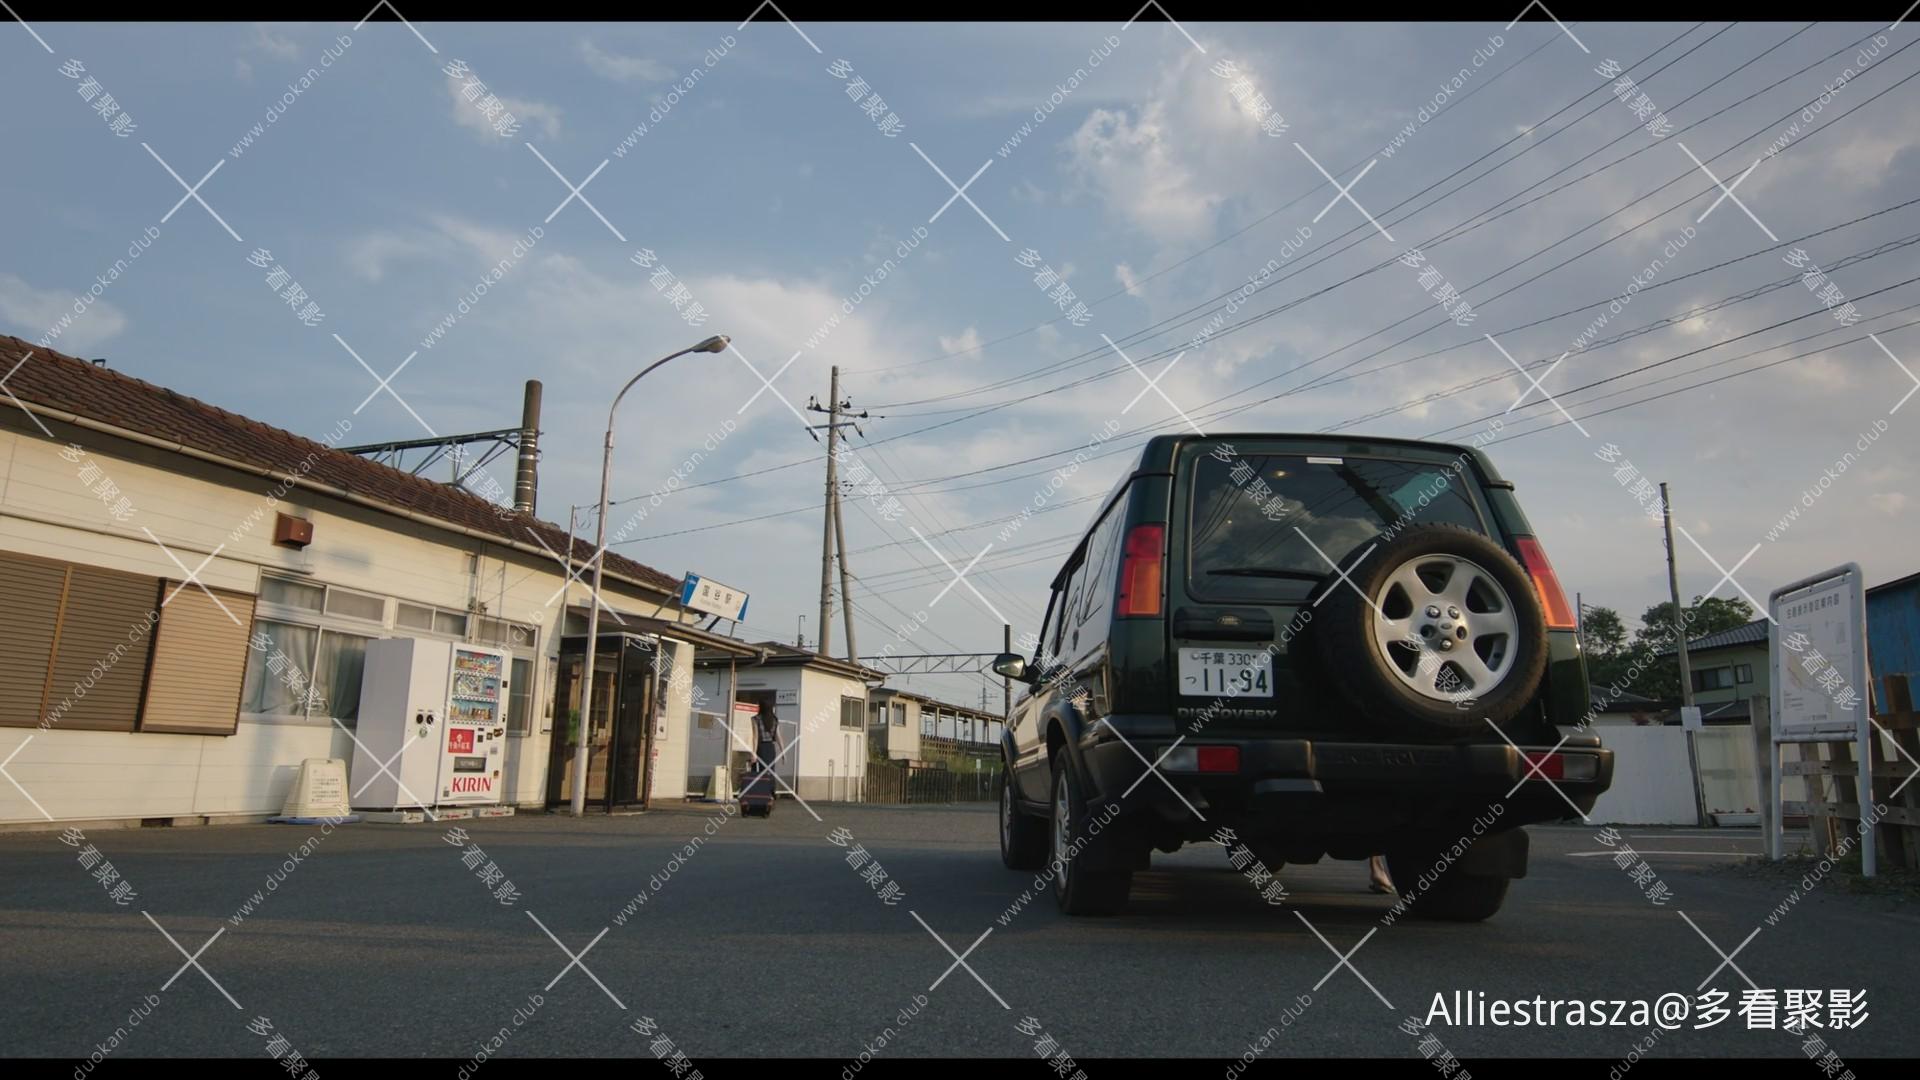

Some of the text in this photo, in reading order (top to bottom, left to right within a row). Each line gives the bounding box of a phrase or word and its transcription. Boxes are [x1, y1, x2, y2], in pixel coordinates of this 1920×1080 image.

[1201, 652, 1252, 666] 千葉 330
[1184, 668, 1268, 693] つ 11-94
[1177, 707, 1278, 719] DISOVERY
[452, 776, 492, 793] KIRIN
